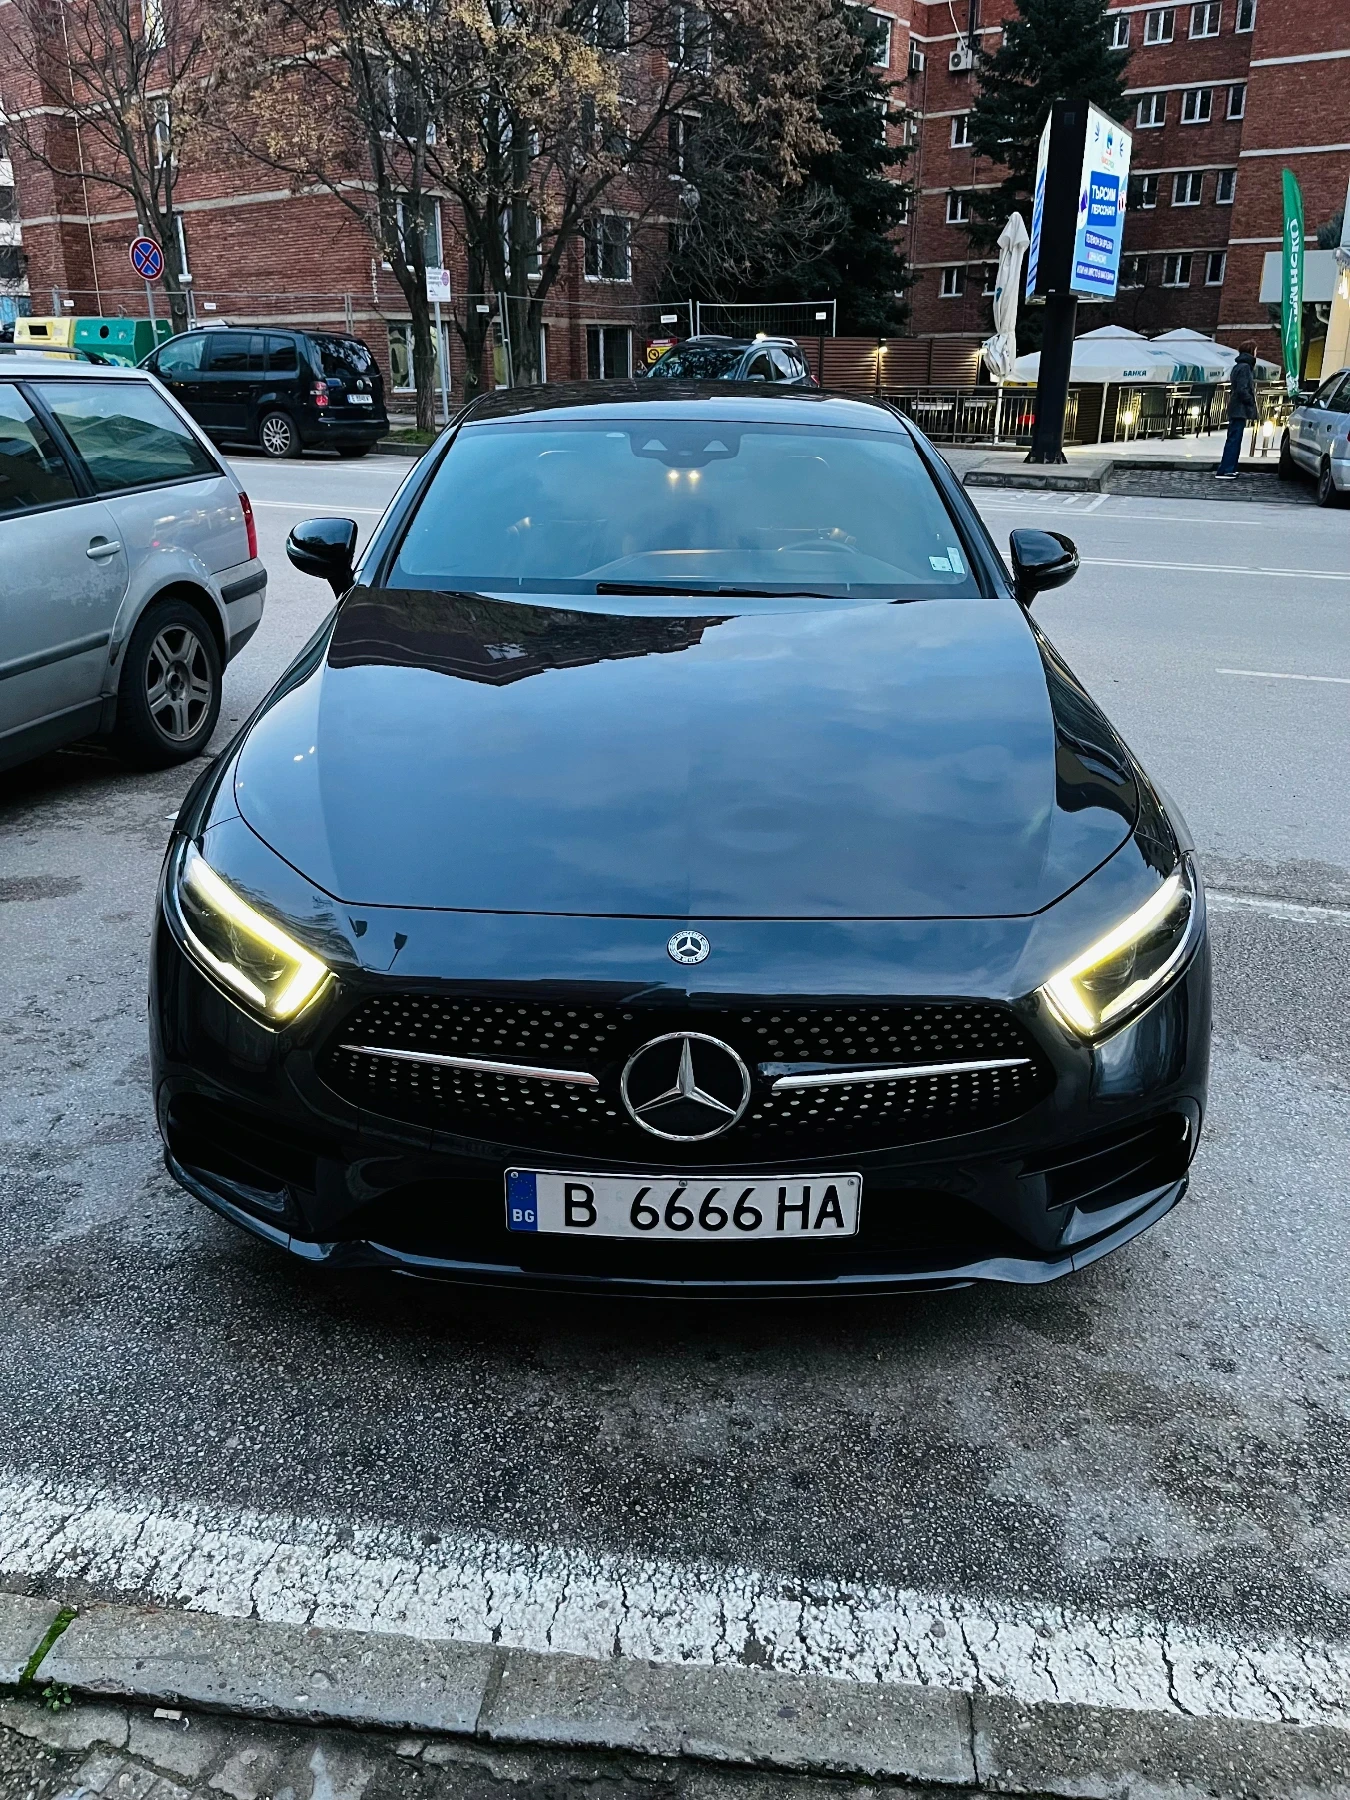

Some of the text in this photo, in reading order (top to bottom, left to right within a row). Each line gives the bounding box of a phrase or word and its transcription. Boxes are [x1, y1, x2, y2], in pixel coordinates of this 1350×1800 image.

[1091, 184, 1117, 202] ТЪРСИМ
[512, 1208, 535, 1223] BG
[564, 1182, 845, 1232] B 6666 HA
